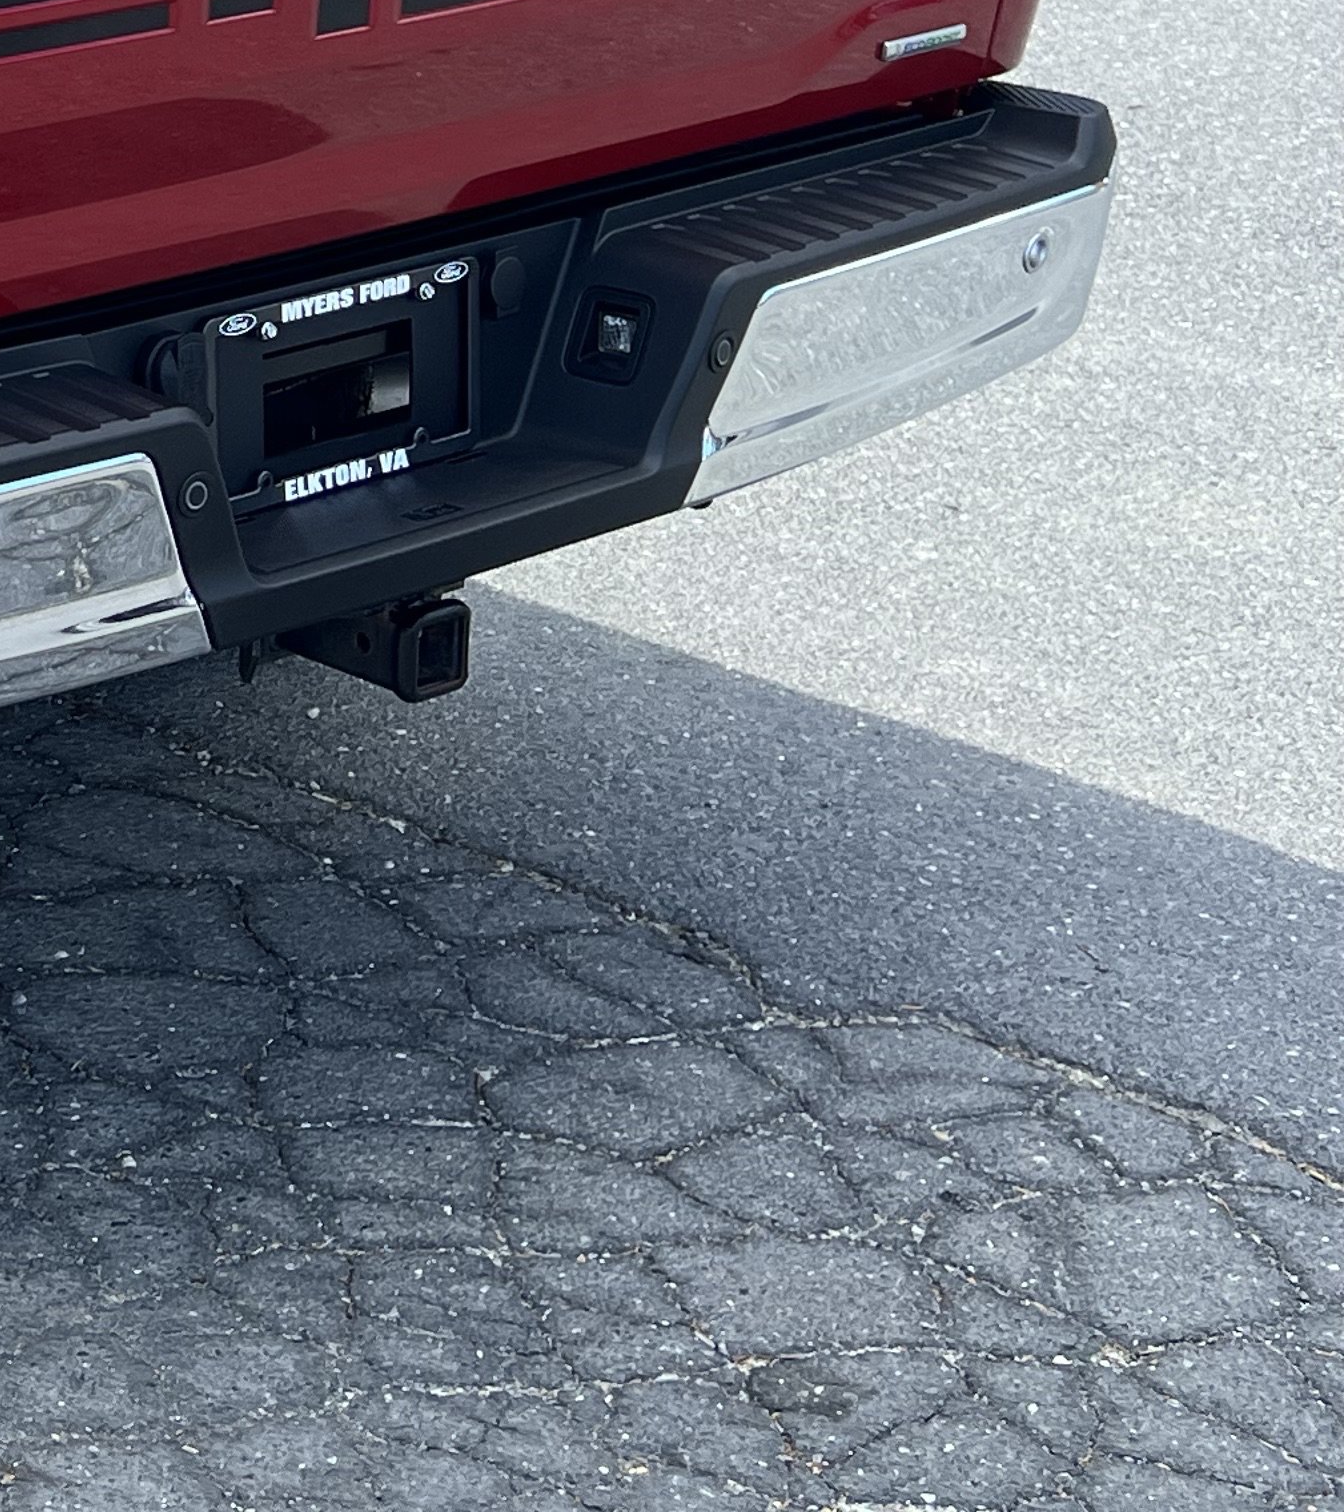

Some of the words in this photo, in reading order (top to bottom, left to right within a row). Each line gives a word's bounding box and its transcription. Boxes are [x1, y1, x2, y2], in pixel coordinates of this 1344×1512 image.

[281, 287, 354, 323] MYERS
[359, 274, 411, 304] FORD
[284, 459, 372, 502] ELKTON,
[378, 448, 410, 474] VA
